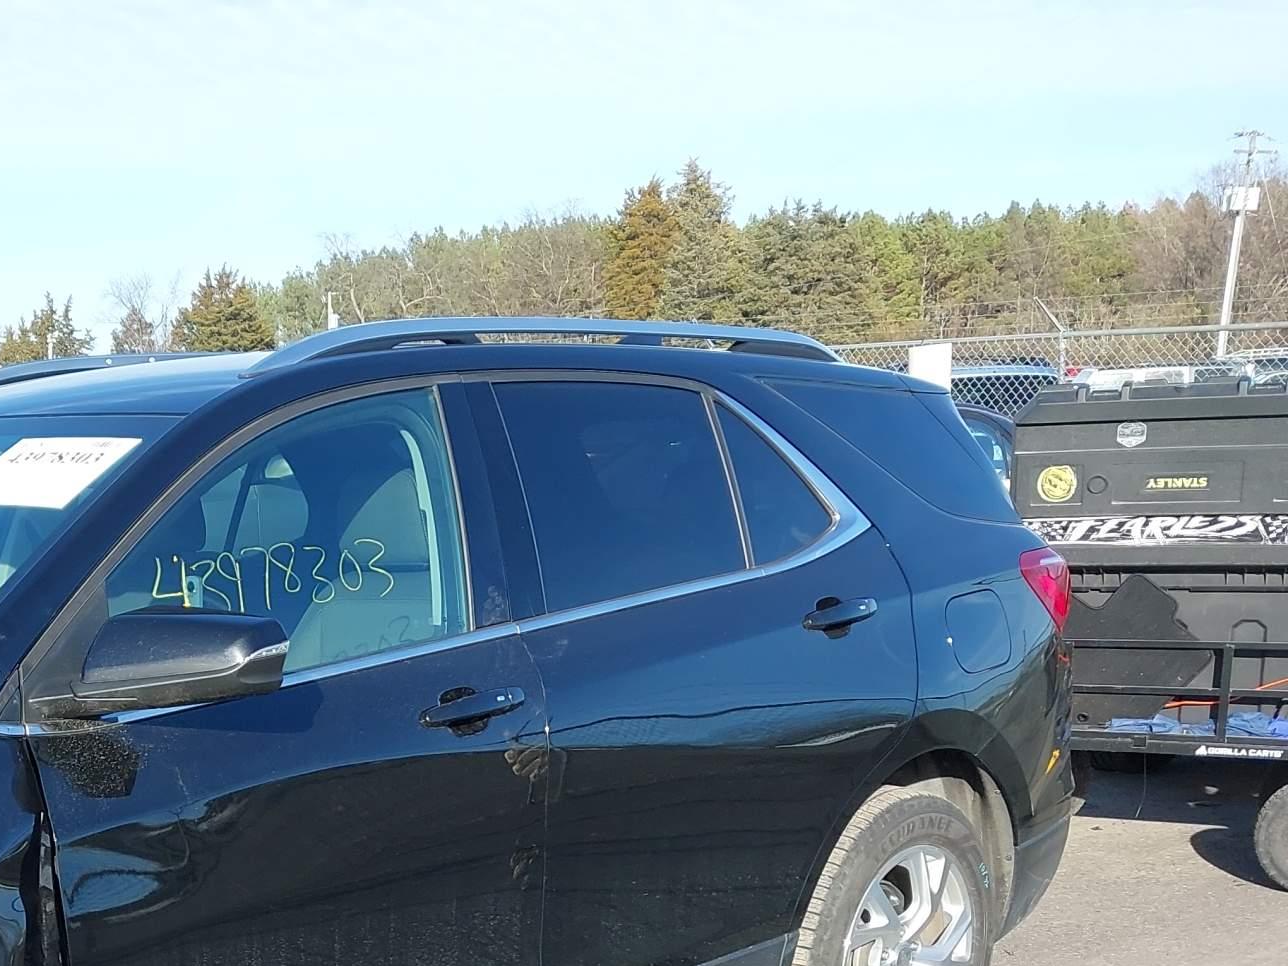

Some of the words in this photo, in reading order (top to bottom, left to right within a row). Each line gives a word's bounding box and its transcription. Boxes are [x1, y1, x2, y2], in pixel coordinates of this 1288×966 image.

[1145, 477, 1208, 489] STANLEY
[151, 539, 394, 614] 43978303
[1207, 747, 1248, 756] GORILLA
[1248, 749, 1282, 758] CARTS
